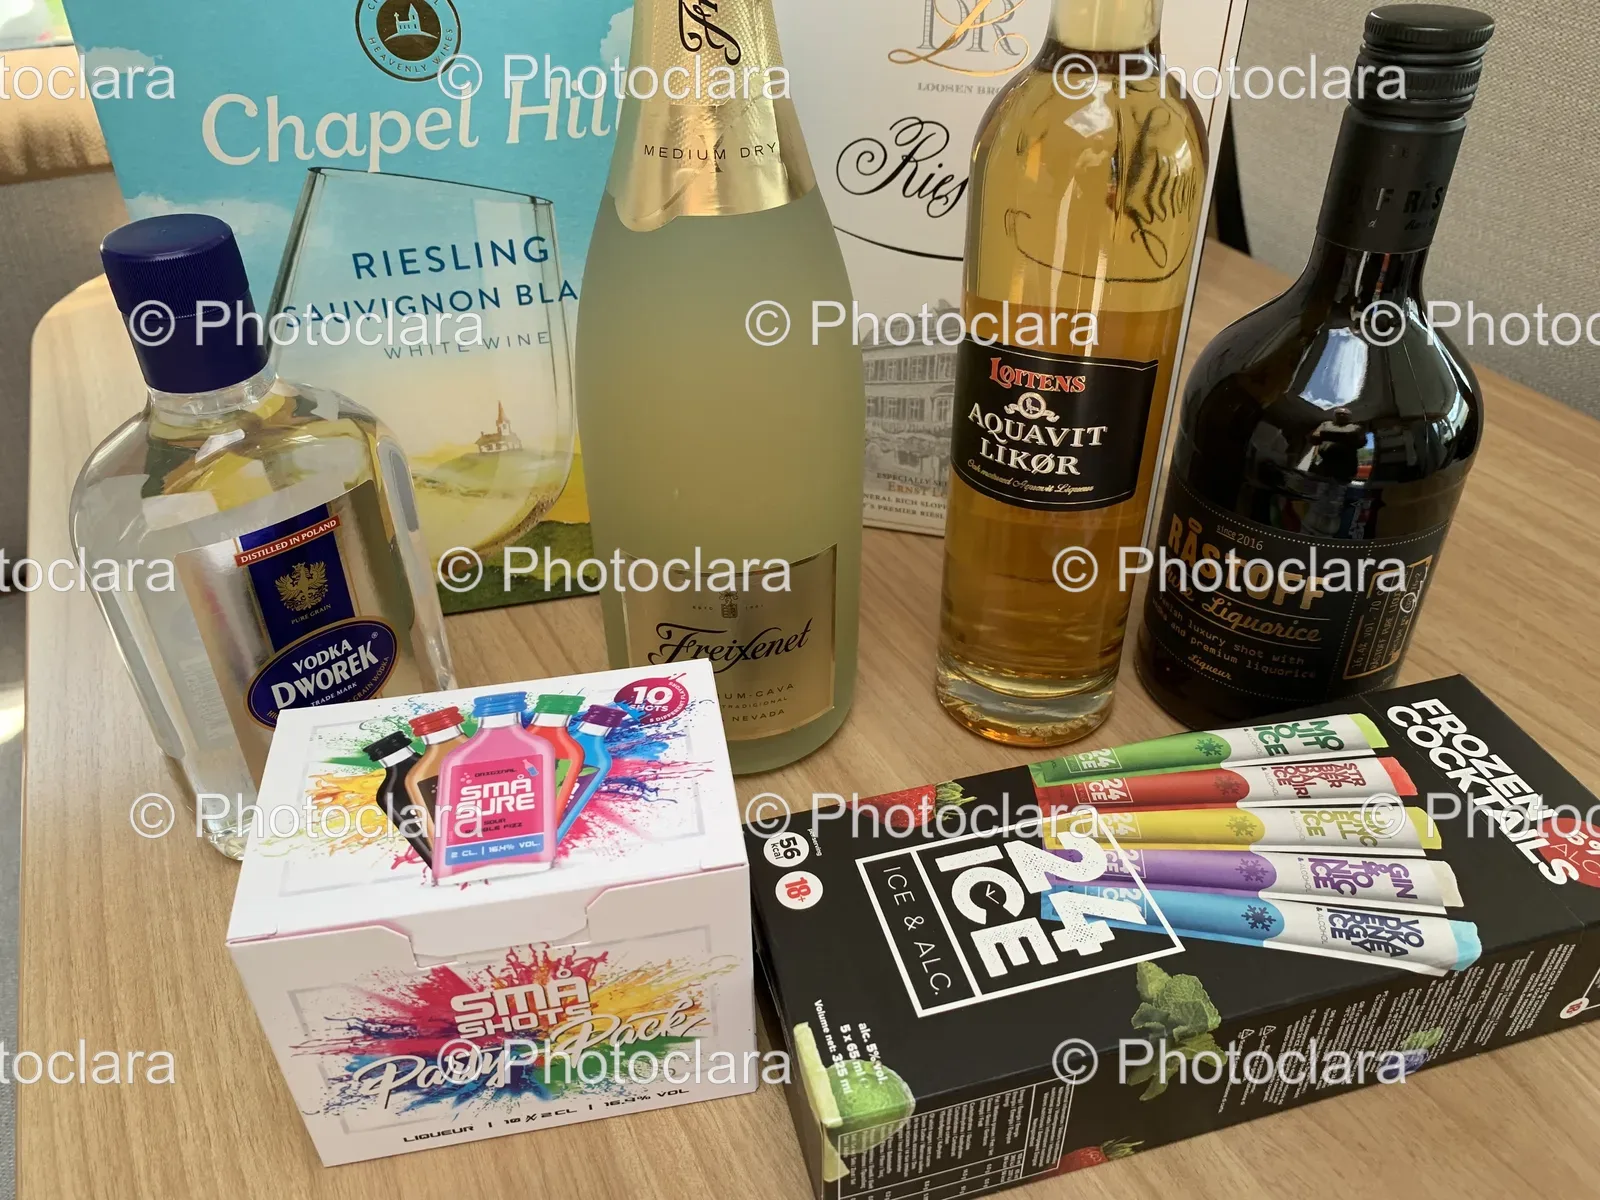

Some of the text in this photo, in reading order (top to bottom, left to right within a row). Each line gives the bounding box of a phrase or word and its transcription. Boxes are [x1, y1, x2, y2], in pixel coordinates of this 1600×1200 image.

[201, 78, 480, 173] Chapel
[644, 142, 776, 161] MEDIUM DRY
[352, 236, 549, 280] RIESLING
[282, 286, 500, 328] SAUVIGNON
[483, 331, 550, 352] WINE
[967, 402, 1109, 448] AQUAVIT
[979, 436, 1081, 476] LIKØR
[241, 519, 337, 564] DISTILLED IN POLAND
[1216, 524, 1264, 551] since 2016
[290, 603, 332, 625] PURE GRAIN
[1188, 619, 1226, 647] luxury
[1201, 595, 1322, 643] Liquorice
[292, 638, 353, 675] VODKA
[647, 617, 814, 674] Freixenet
[1190, 636, 1239, 665] premium
[271, 641, 379, 710] DWOREK
[310, 682, 358, 707] TRADE MARK
[633, 686, 674, 705] 10
[732, 708, 785, 723] NEVADA
[1253, 726, 1289, 757] ICE
[1411, 698, 1558, 821] FROZEN
[456, 792, 535, 820] SURE
[459, 774, 533, 802] SMÅ
[1387, 705, 1580, 885] COCKTAILS
[465, 825, 502, 834] BUBLE
[780, 836, 802, 860] 56
[770, 842, 784, 860] kcal
[935, 844, 1059, 979] ICE
[1004, 829, 1148, 958] 24
[880, 866, 916, 907] ICE
[913, 941, 953, 997] ALC.
[450, 969, 593, 1024] SMÅ
[455, 1002, 597, 1040] SHOTS
[814, 999, 830, 1034] Volume
[825, 1034, 838, 1053] net:
[840, 1024, 867, 1077] 5 x 65 ml
[858, 1022, 871, 1043] alc.
[866, 1043, 881, 1062] 5%
[403, 1125, 474, 1143] LIQUEUR
[656, 1088, 691, 1098] VOL
